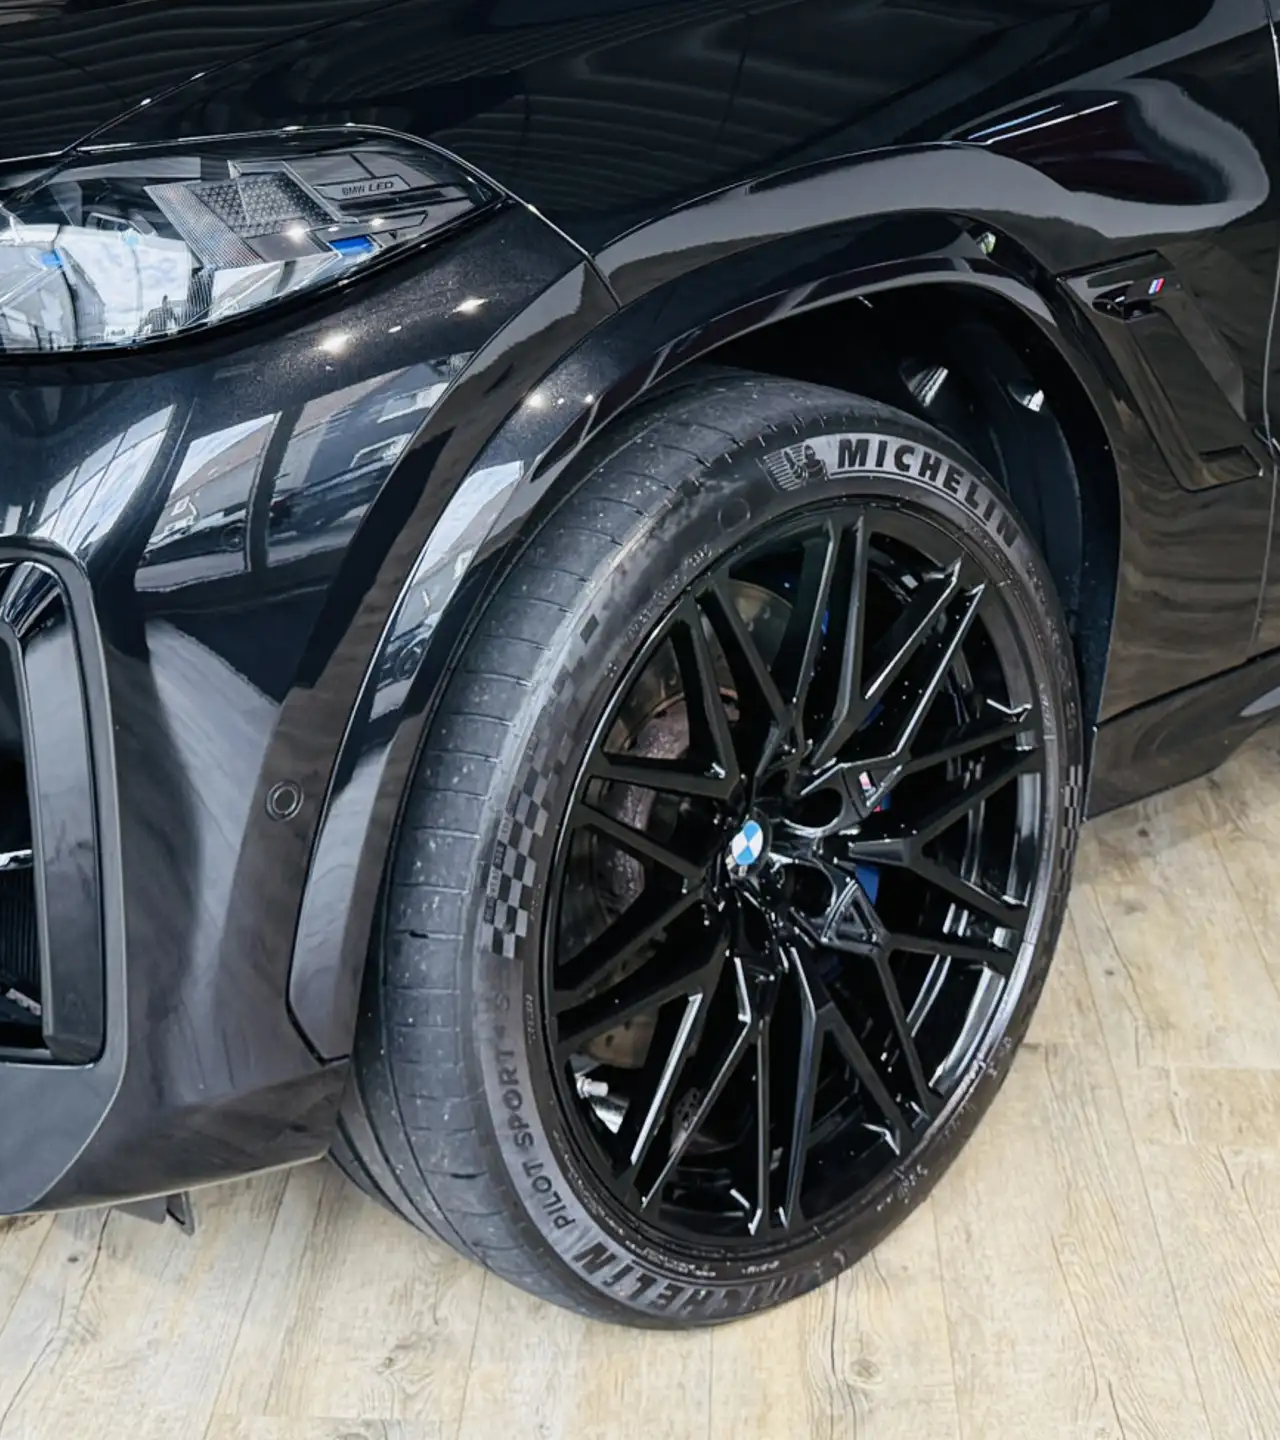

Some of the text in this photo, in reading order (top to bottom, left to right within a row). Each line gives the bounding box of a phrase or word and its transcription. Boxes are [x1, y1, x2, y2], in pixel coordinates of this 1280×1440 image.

[368, 181, 394, 192] LED
[836, 437, 1022, 548] MICHELIN
[496, 1048, 535, 1150] SPORT
[521, 1158, 577, 1231] PILOT
